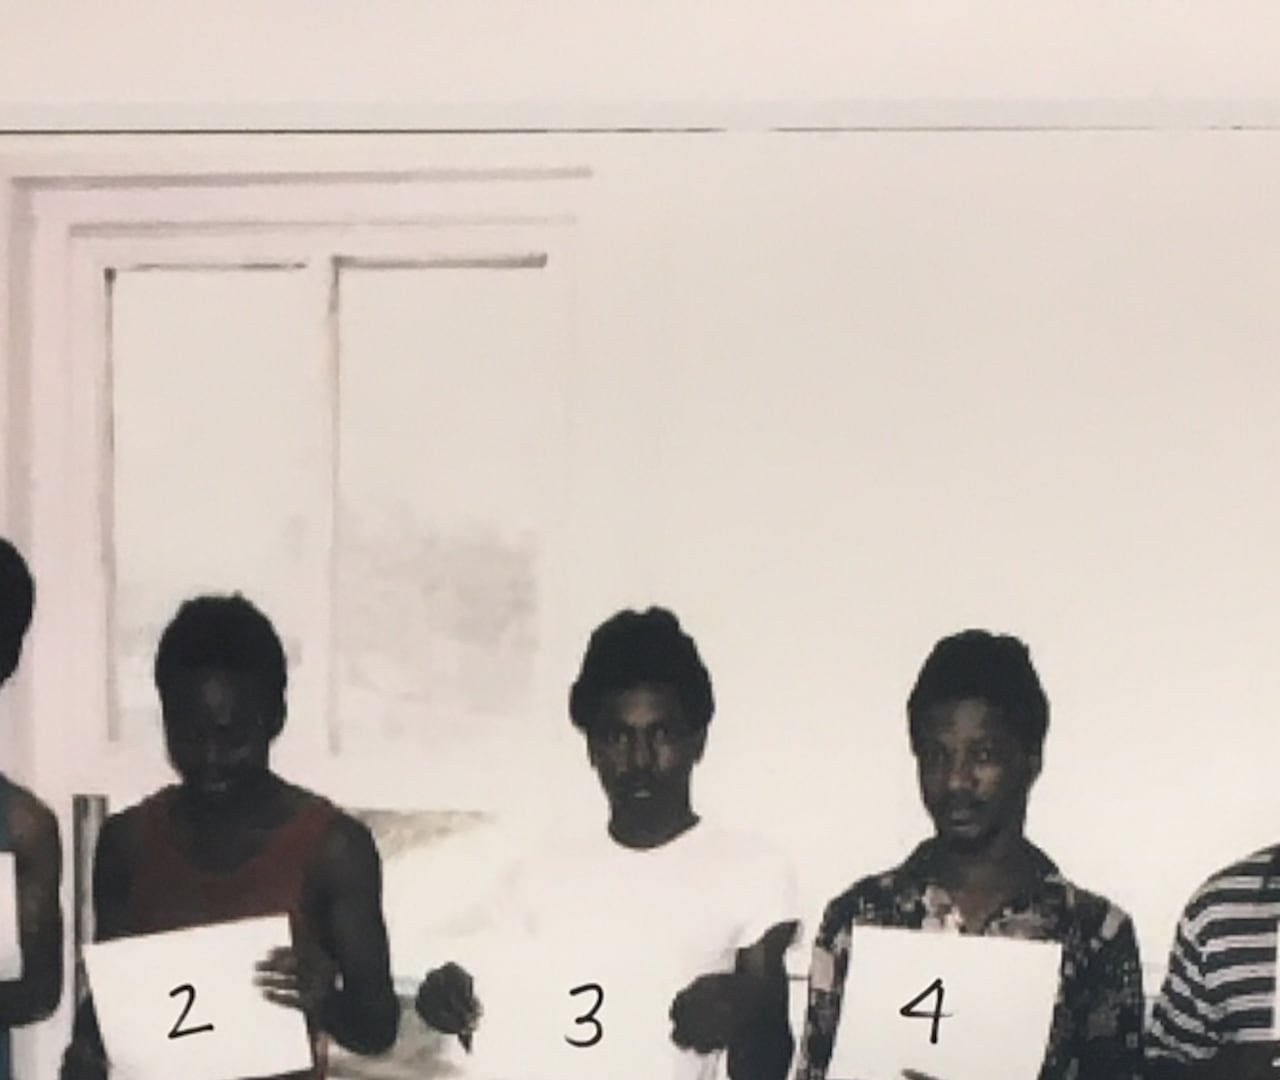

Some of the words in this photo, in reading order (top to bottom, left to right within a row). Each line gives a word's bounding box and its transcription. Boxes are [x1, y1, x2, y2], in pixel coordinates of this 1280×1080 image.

[167, 983, 215, 1041] 2
[564, 982, 605, 1049] 3
[898, 977, 953, 1046] 4
